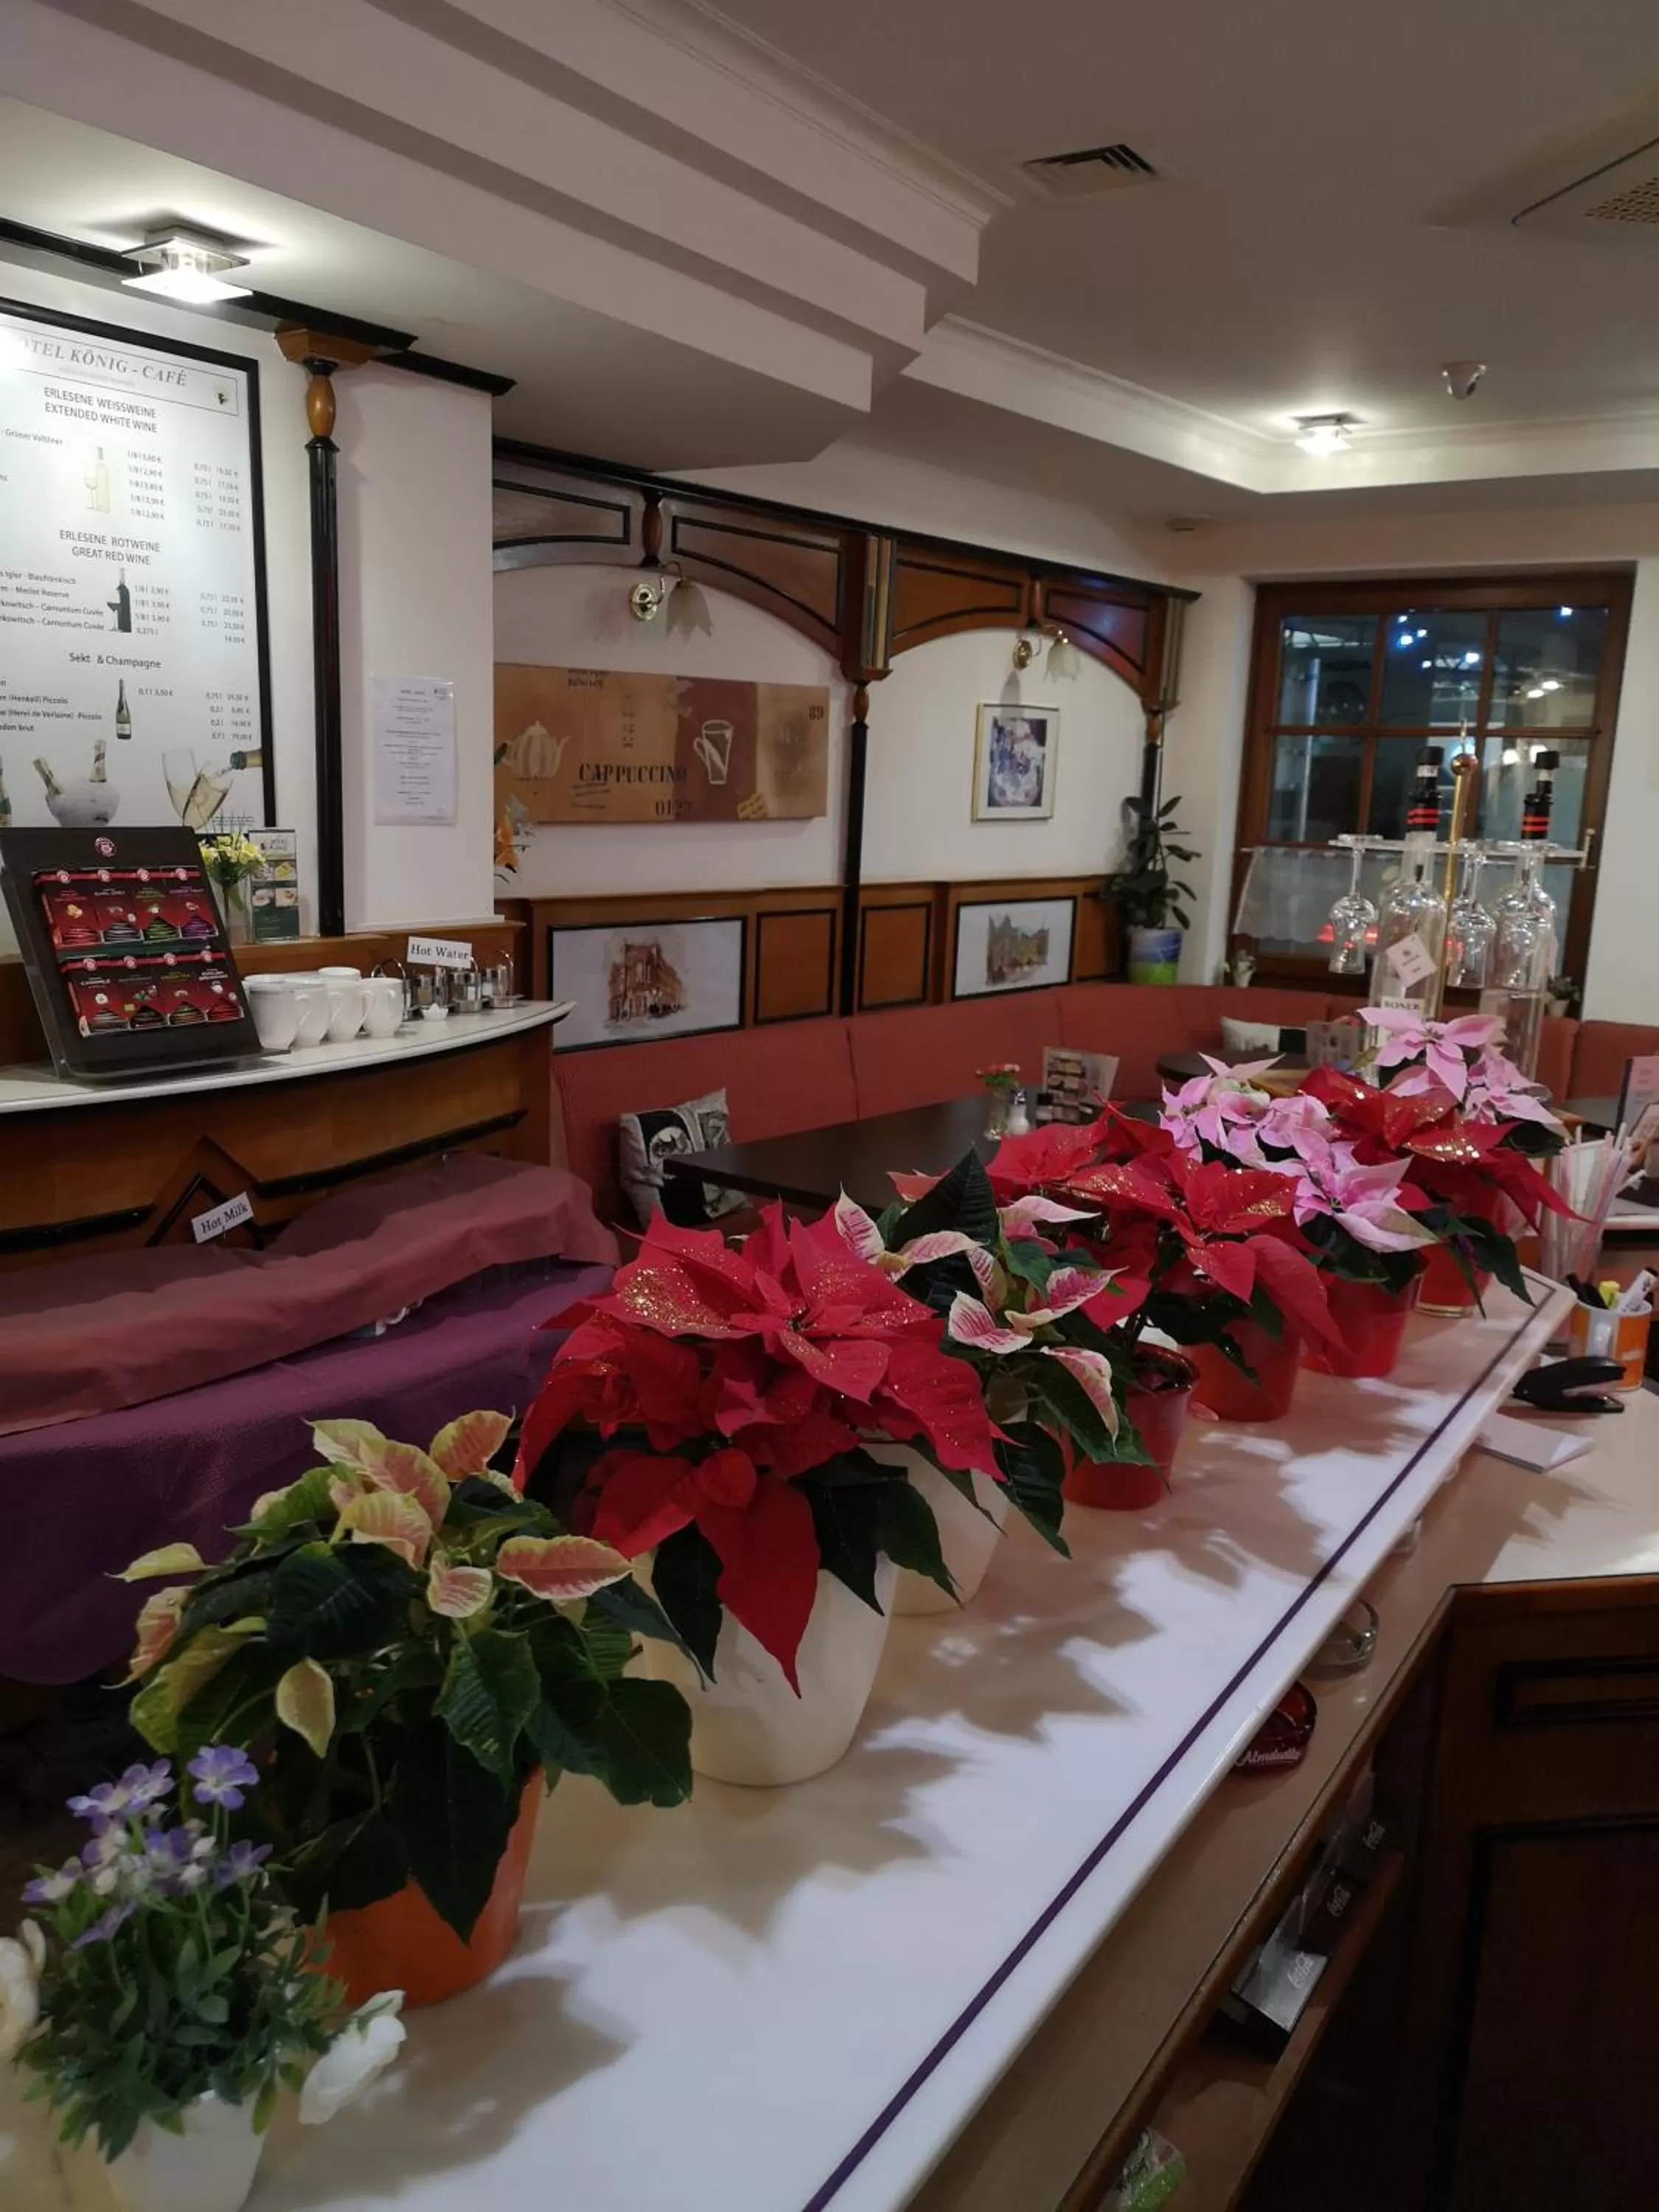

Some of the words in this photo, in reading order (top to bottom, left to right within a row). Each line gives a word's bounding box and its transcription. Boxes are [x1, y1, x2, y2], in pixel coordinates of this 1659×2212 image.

[70, 347, 129, 374] KÖNIG
[142, 365, 188, 387] CAFÉ
[44, 386, 94, 406] ERLESENE
[97, 397, 157, 419] WEISSWEINE
[45, 402, 98, 422] EXTENDED
[100, 414, 131, 428] WHITE
[133, 420, 158, 434] WINE
[59, 529, 108, 545] ERLESENE
[111, 532, 161, 553] ROTWEINE
[72, 546, 103, 560] GREAT
[105, 549, 125, 563] RED
[126, 552, 151, 566] WINE
[69, 652, 91, 664] Sekt
[97, 654, 104, 664] &
[105, 655, 161, 669] Champagne
[579, 762, 687, 785] CAPPUCCINO
[411, 943, 432, 956] Hot
[436, 946, 469, 959] Water
[201, 1217, 222, 1234] Hot
[223, 1202, 248, 1223] Milk
